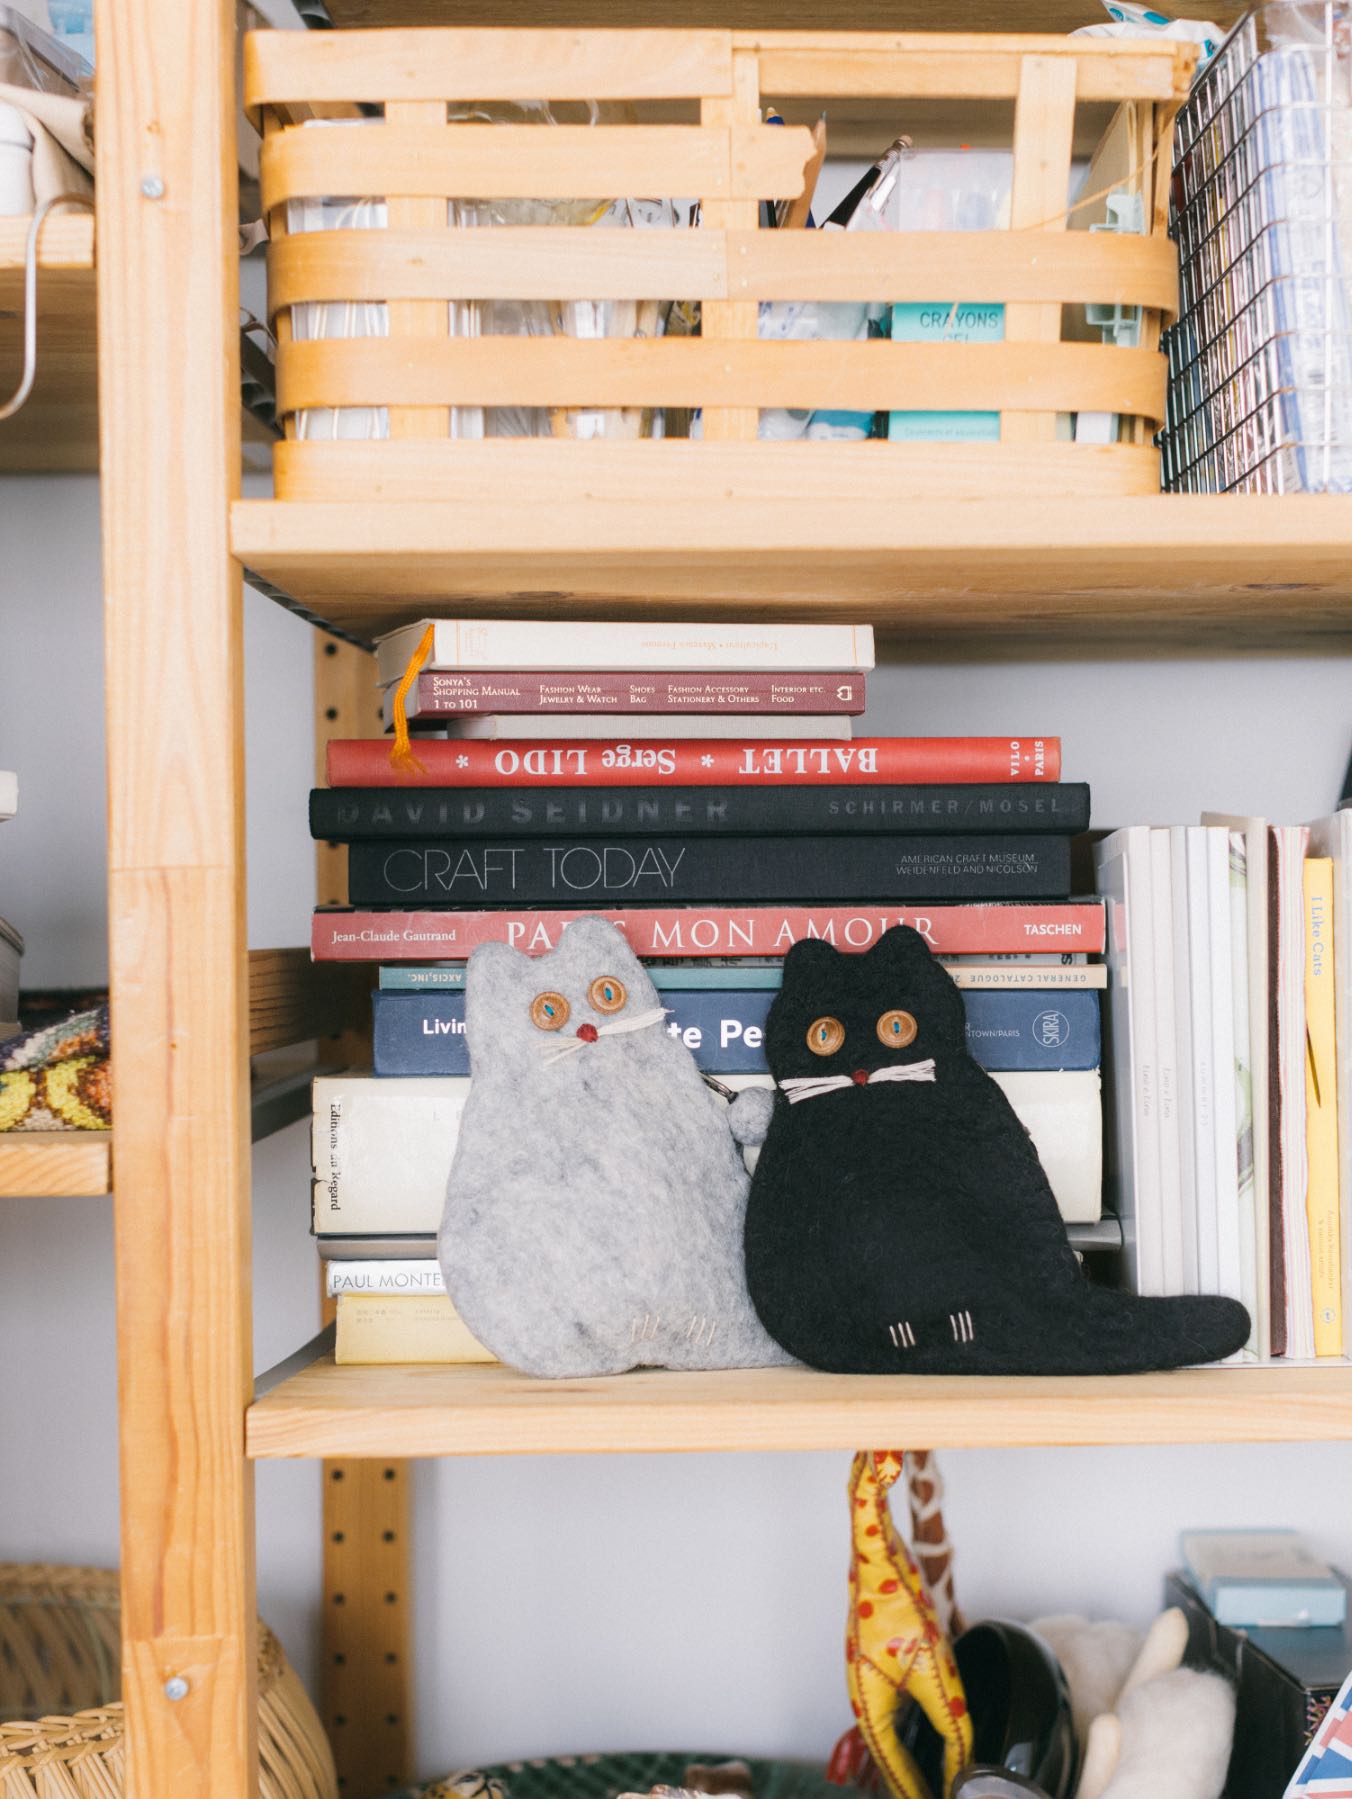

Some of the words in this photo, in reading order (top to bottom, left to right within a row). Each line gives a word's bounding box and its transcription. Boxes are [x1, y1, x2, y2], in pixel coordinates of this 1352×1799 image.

[920, 312, 998, 328] CRAYONS
[433, 677, 471, 686] SONYA'S
[433, 686, 479, 696] SHOPPING
[481, 686, 521, 696] MANUAL
[539, 685, 575, 694] FASHION
[668, 685, 702, 694] FASHION
[705, 685, 749, 694] ACCESSORY
[771, 685, 807, 693] INTERIOR
[434, 700, 440, 709] 1
[459, 700, 478, 709] 101
[539, 695, 574, 705] JEWELRY
[576, 695, 585, 704] &
[586, 695, 618, 704] WATCH
[630, 695, 647, 704] BAG
[668, 695, 715, 704] STATIONERY
[717, 695, 726, 703] &
[728, 695, 760, 703] OTHERS
[771, 695, 795, 703] FOOD
[495, 750, 588, 775] LIDO
[602, 745, 676, 775] Serge
[739, 748, 878, 774] BALLET
[1010, 741, 1020, 776] VILO
[1034, 741, 1044, 776] PARIS
[511, 799, 728, 824] SEIDNER
[901, 855, 953, 864] AMERICAN
[955, 854, 987, 863] CRAFT
[989, 853, 1035, 863] MUSEUM
[384, 849, 525, 891] CRAFT
[543, 848, 686, 889] TODAY
[963, 864, 984, 874] AND
[650, 919, 755, 948] MON
[1024, 924, 1082, 935] TASCHEN
[331, 930, 400, 944] Jean-Claude
[403, 929, 456, 941] Gautrand
[1312, 942, 1325, 976] Cats
[970, 974, 1034, 983] CATALOGUE
[1037, 974, 1087, 982] GENERAL
[423, 1019, 467, 1035] Livin
[720, 1019, 763, 1048] Pe
[965, 1030, 1020, 1038] NTOWN/PARIS
[1042, 1013, 1060, 1044] SKIRA
[333, 1274, 374, 1289] PAUL
[379, 1272, 441, 1288] MONTE
